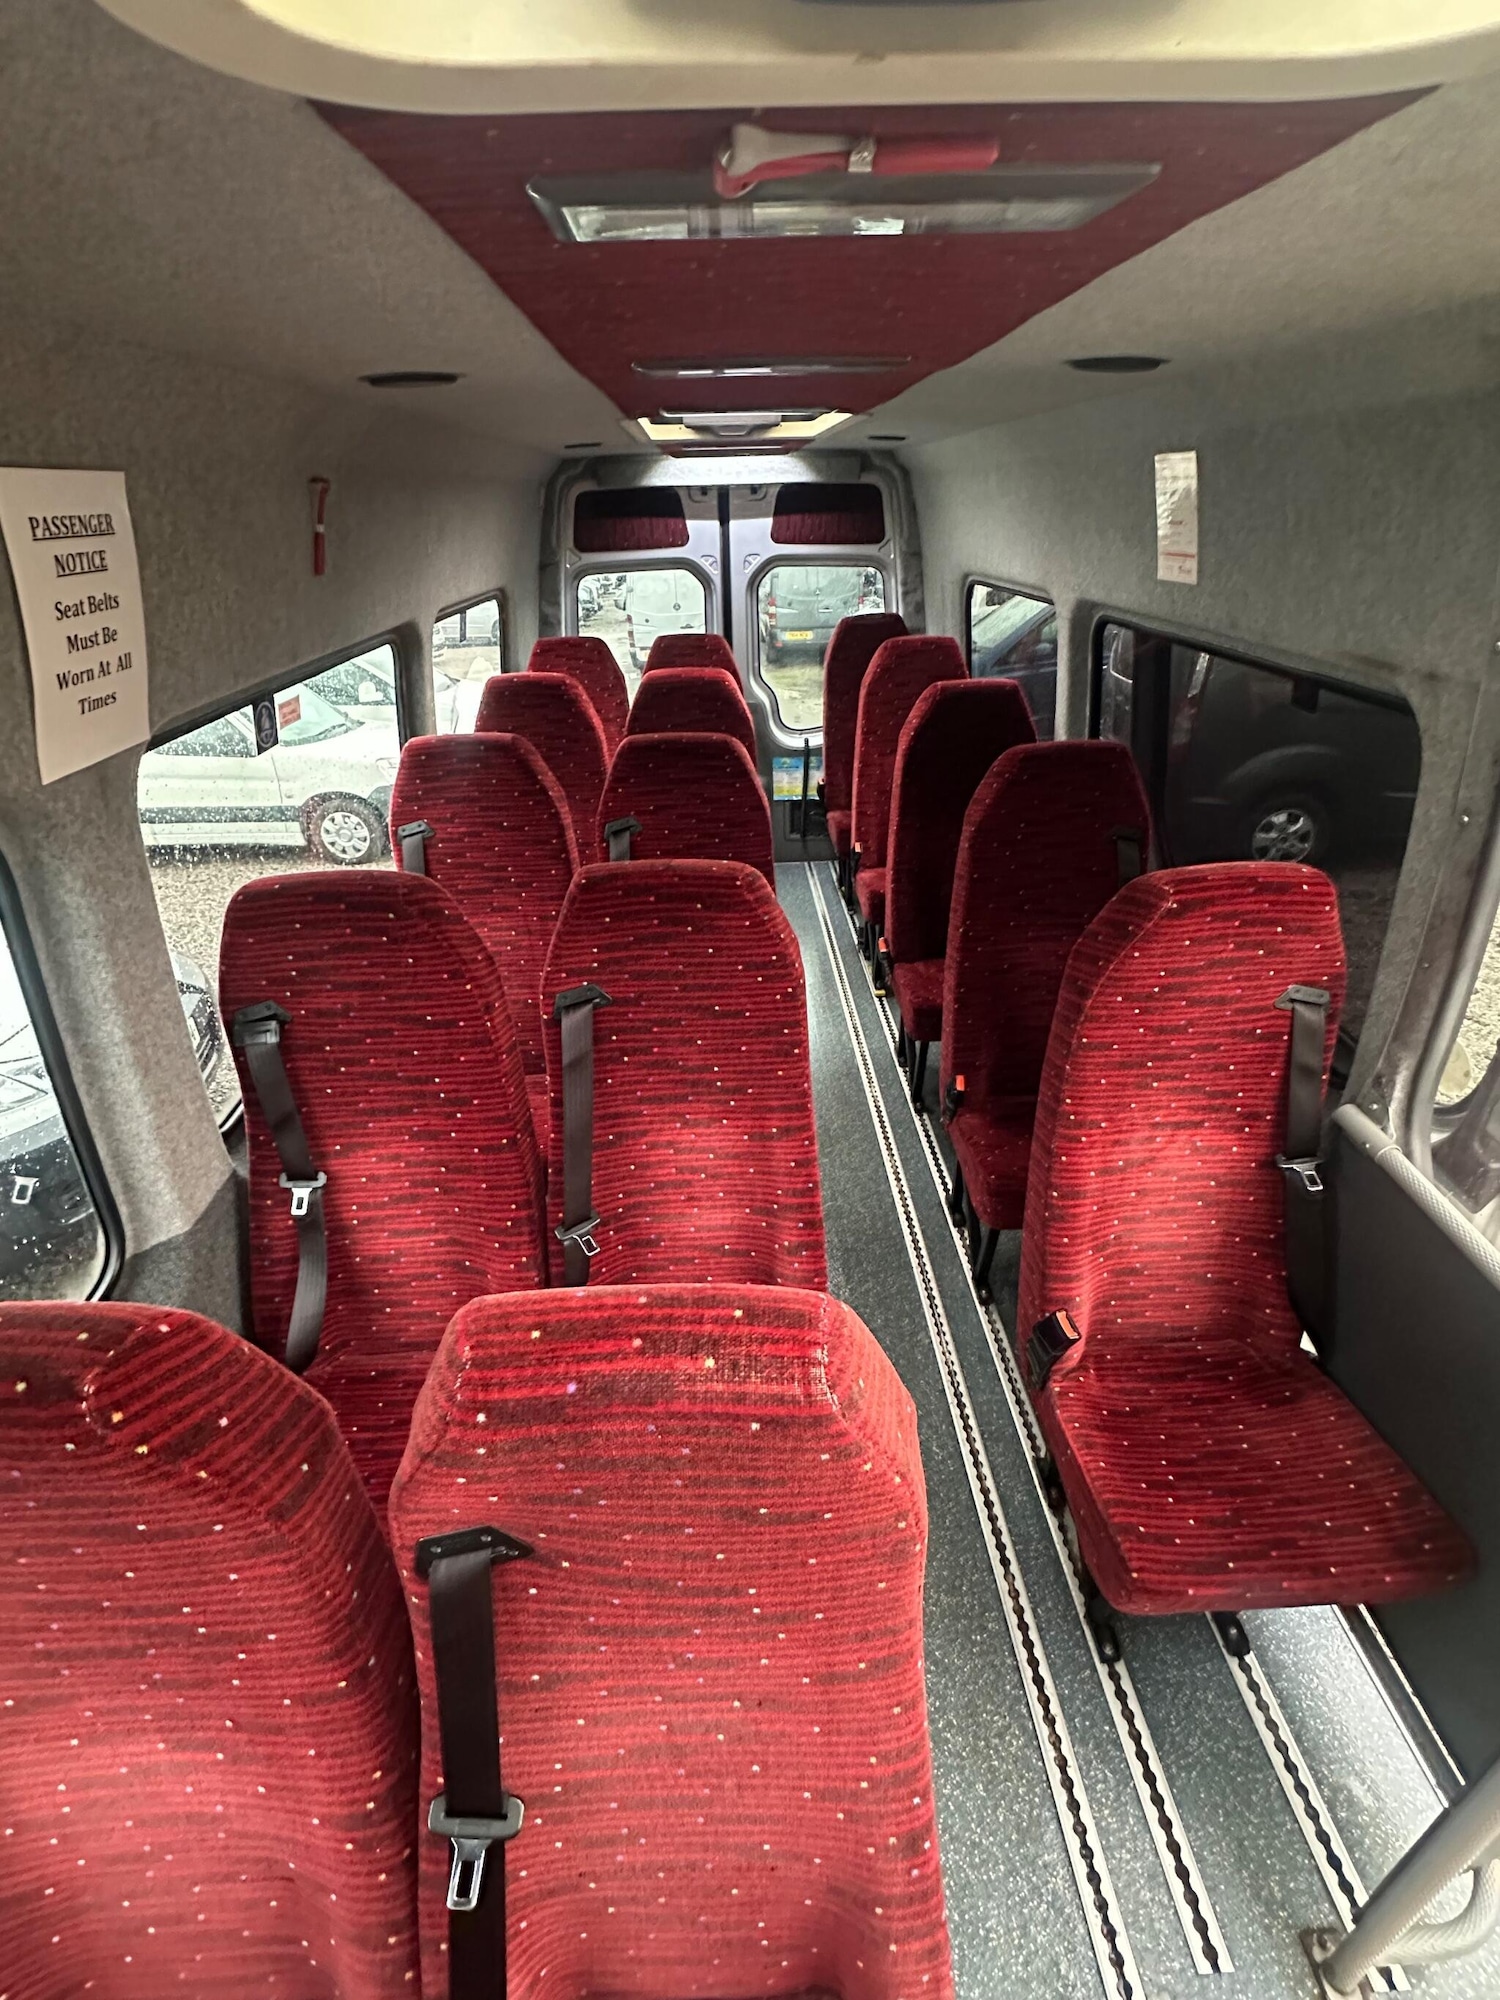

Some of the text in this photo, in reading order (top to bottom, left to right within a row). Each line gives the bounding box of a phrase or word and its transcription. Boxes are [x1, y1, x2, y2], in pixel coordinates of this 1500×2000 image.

[28, 513, 115, 538] PASSENGER
[54, 550, 107, 575] NOTICE
[55, 592, 119, 621] Seat Belts
[66, 626, 118, 654] Must Be
[56, 652, 132, 690] Worn At All
[78, 691, 117, 715] Times
